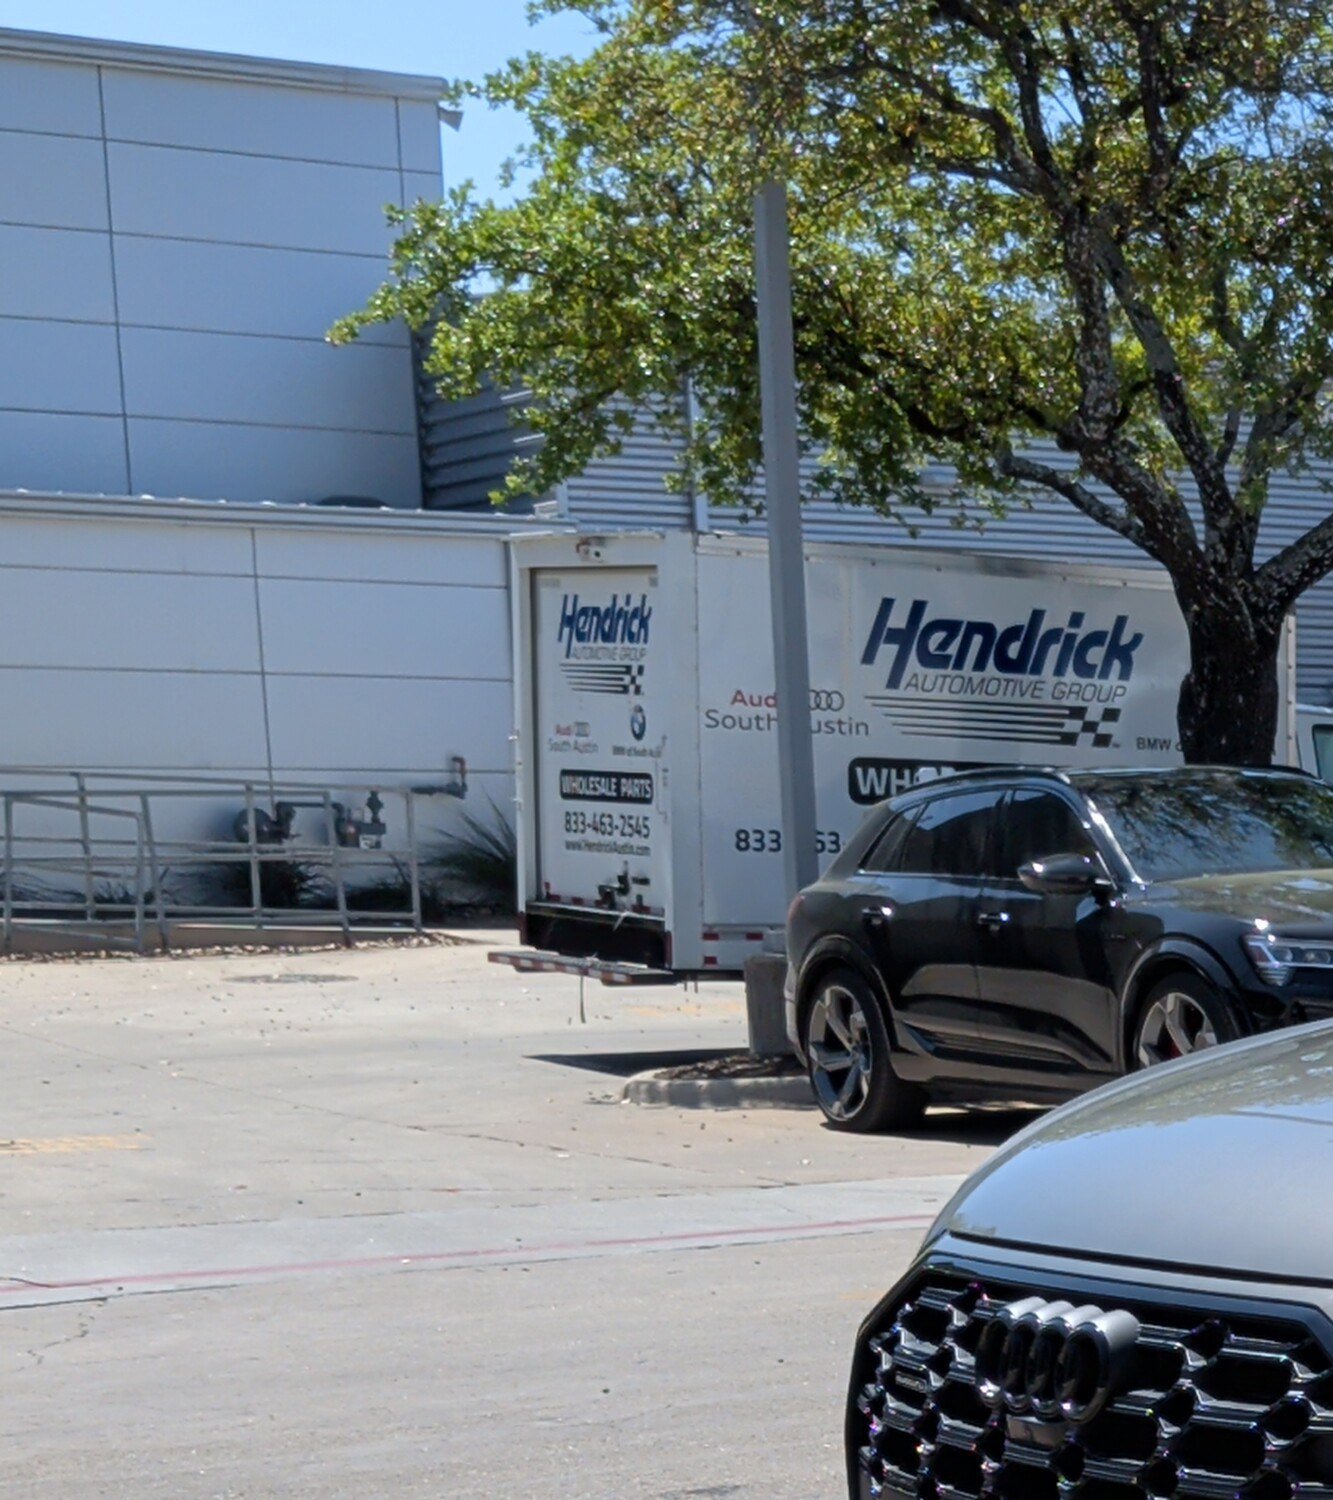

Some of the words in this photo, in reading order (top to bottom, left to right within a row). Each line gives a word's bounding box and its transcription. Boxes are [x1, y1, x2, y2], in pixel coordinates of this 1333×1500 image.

[557, 593, 653, 659] Hendrick
[860, 597, 1145, 690] Hendrick
[730, 689, 777, 708] Aud
[904, 672, 1046, 699] AUTOMOTIVE
[1051, 681, 1128, 704] GROUP
[811, 716, 869, 736] ustin
[1136, 736, 1172, 751] BMW
[561, 775, 618, 797] WHOLESALE
[620, 777, 652, 799] PARTS
[564, 811, 651, 840] 833-463-2545
